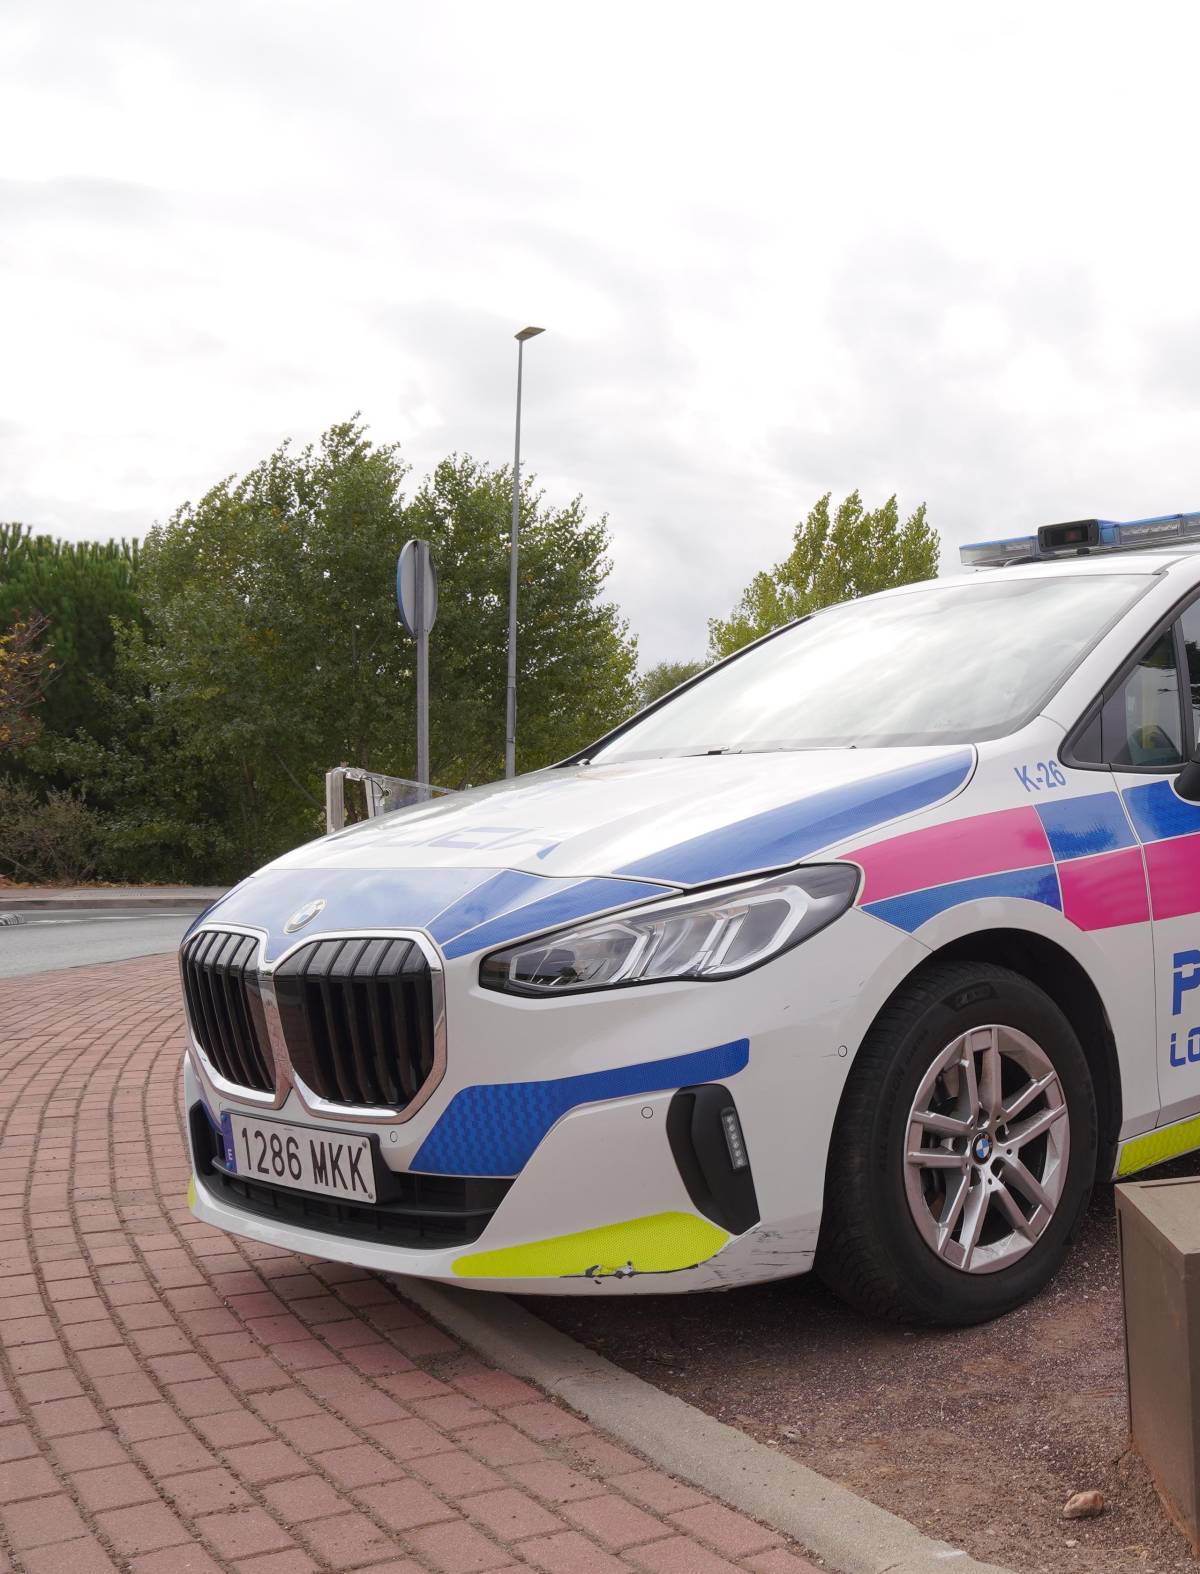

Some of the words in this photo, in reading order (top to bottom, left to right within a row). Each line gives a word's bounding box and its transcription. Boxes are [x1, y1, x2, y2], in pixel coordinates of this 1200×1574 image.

[1013, 760, 1066, 792] K-26
[241, 1127, 302, 1181] 1286
[309, 1139, 369, 1194] MKK
